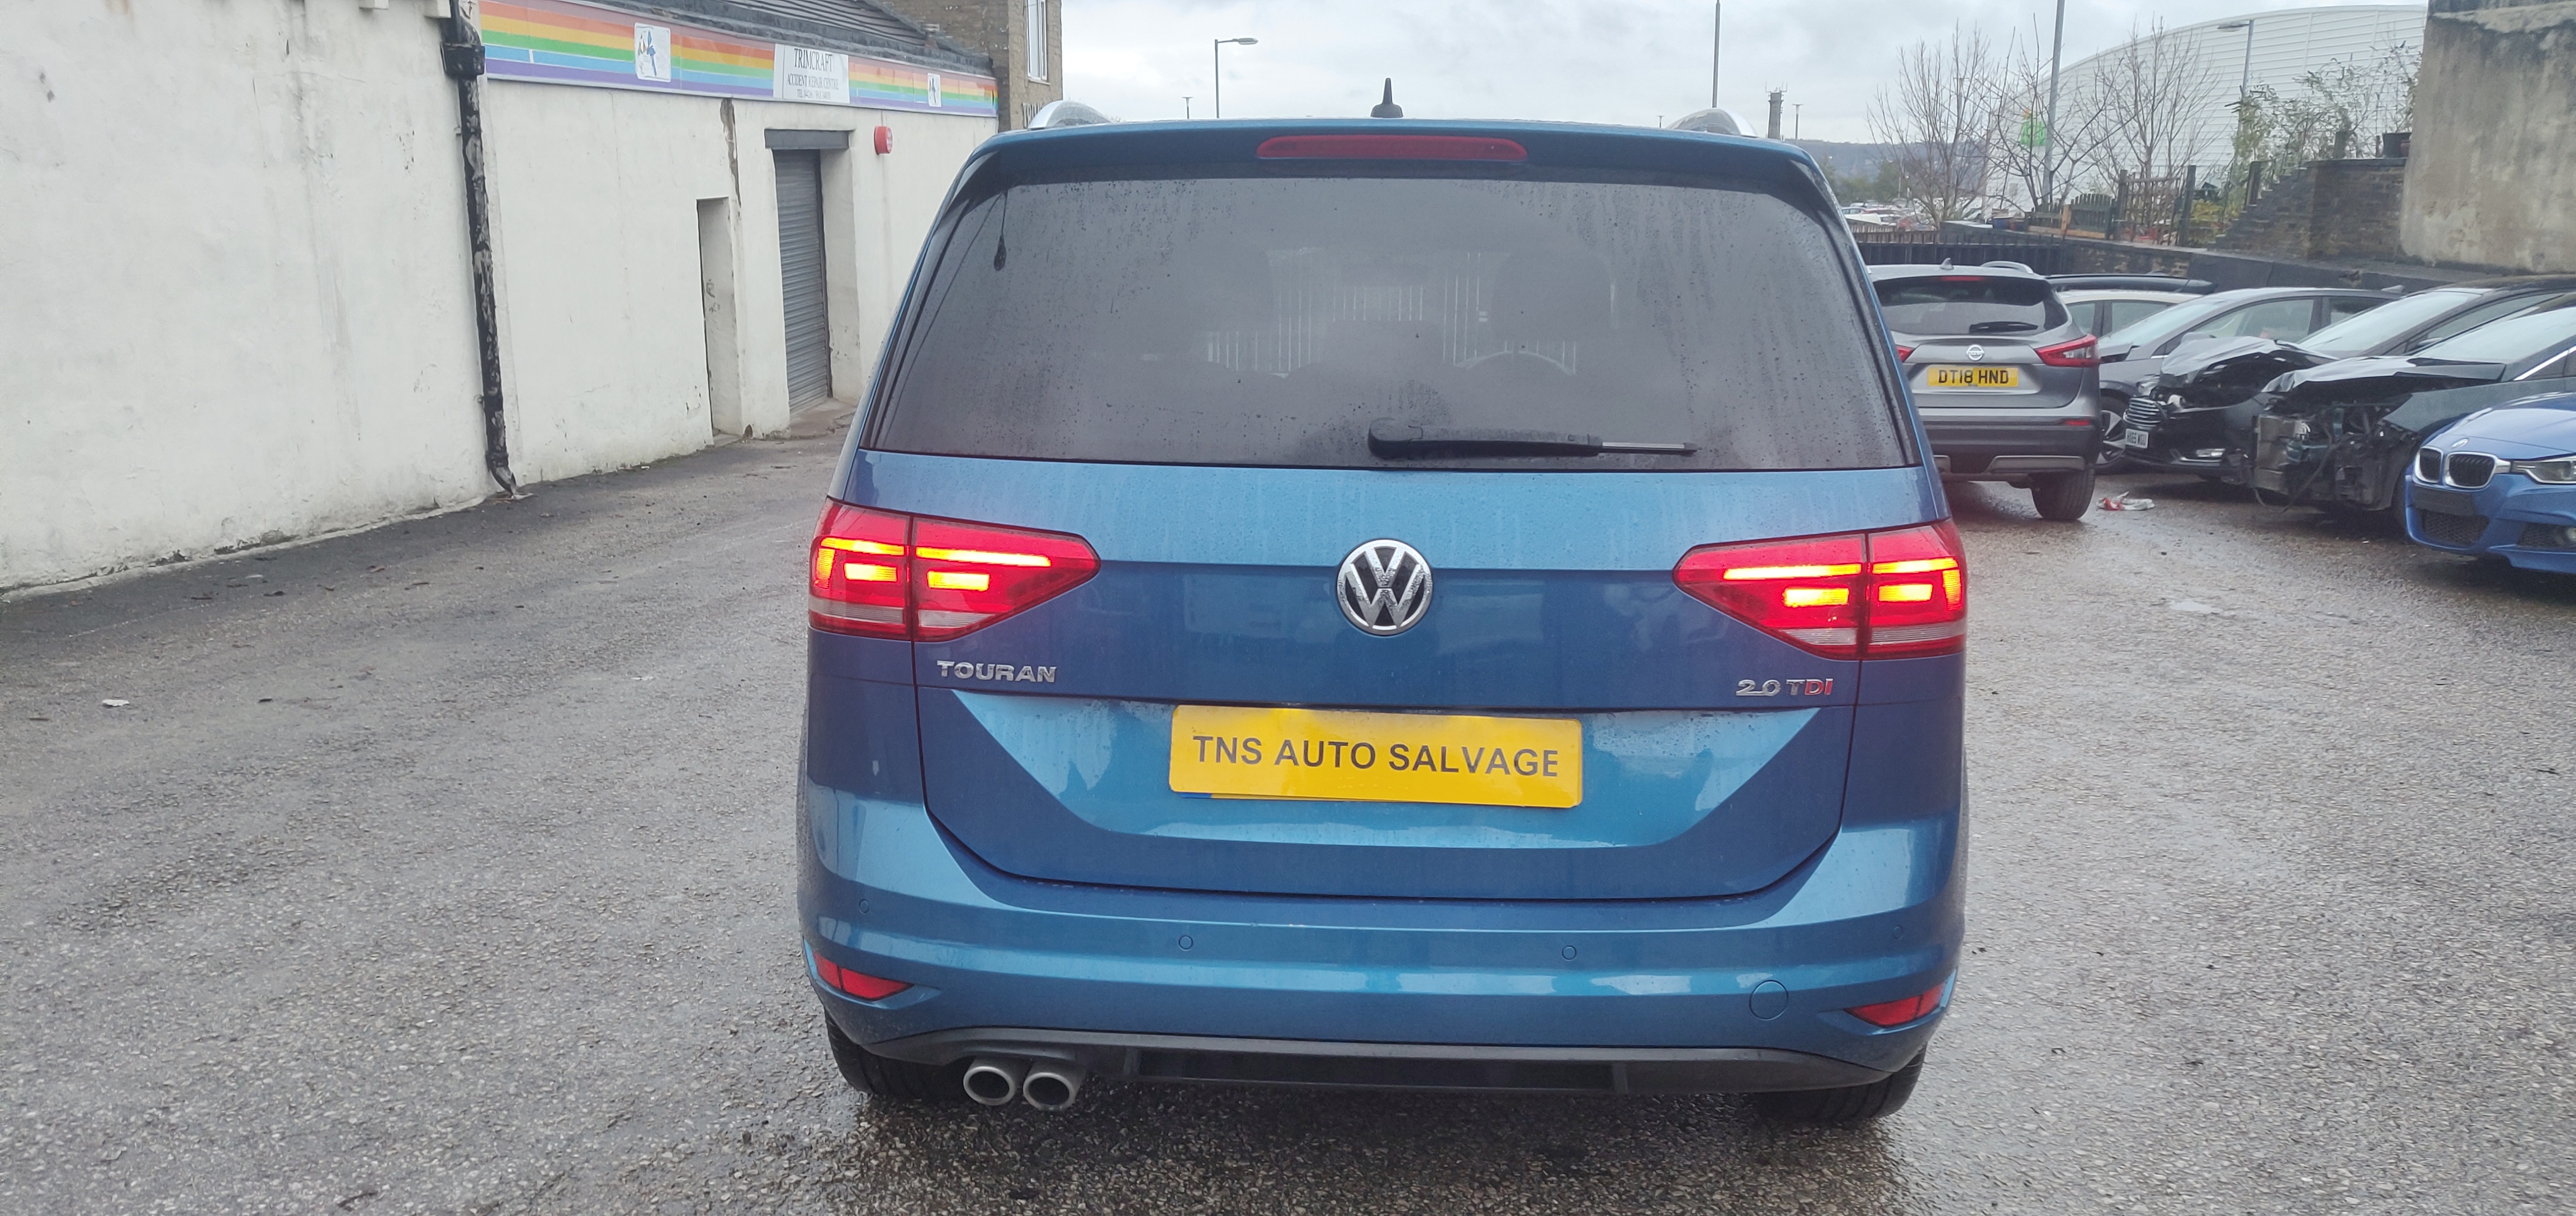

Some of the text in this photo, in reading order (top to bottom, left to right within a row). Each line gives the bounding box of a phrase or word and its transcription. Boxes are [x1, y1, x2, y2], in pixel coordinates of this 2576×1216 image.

[794, 48, 833, 72] TRIMCRAFT
[787, 73, 808, 87] ACCIDENT
[808, 75, 823, 88] REPAIR
[1938, 369, 2009, 384] DT18 HND
[936, 660, 1057, 683] TOURAN
[1786, 678, 1834, 696] TDI
[1192, 735, 1559, 777] TNS AUTO SALVAGE
